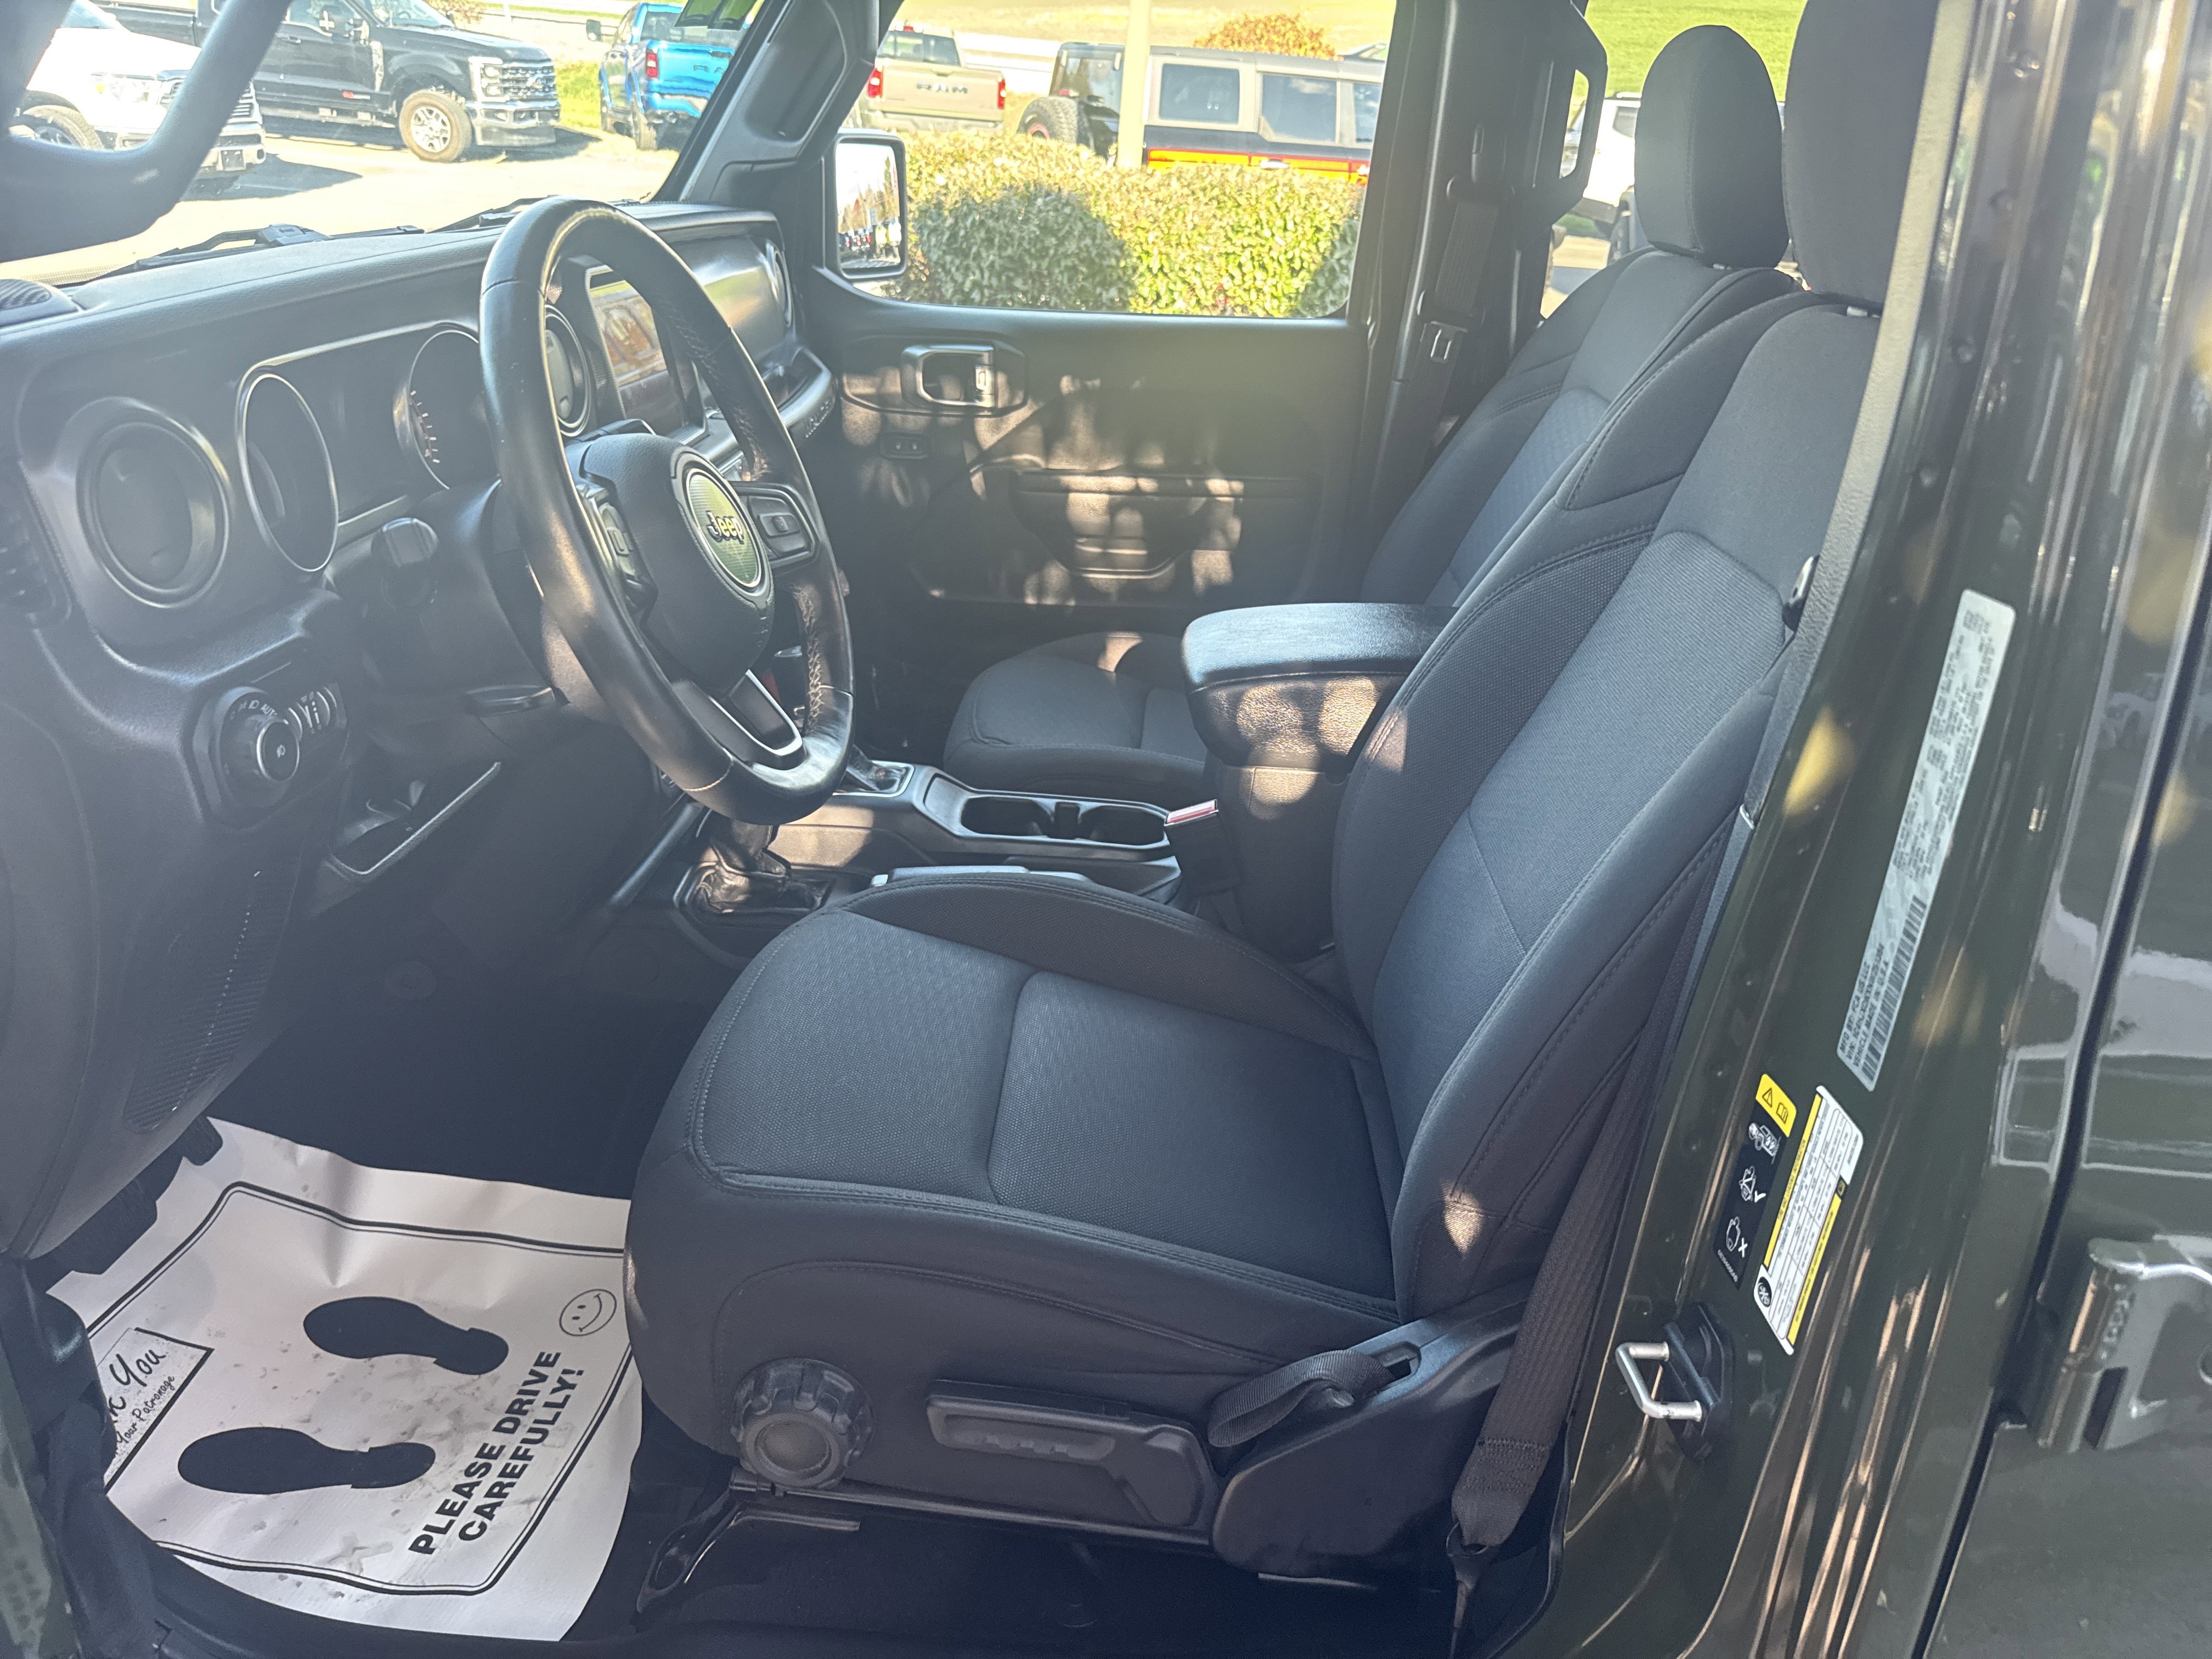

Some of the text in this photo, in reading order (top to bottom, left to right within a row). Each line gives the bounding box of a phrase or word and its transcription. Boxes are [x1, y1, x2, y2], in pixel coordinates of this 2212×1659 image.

[916, 82, 968, 94] RAM
[706, 510, 744, 545] Jeep
[110, 1350, 166, 1387] You
[132, 1375, 175, 1421] Patronage
[408, 1351, 561, 1554] PLEASE DRIVE
[459, 1368, 584, 1541] CAREFULLY!
